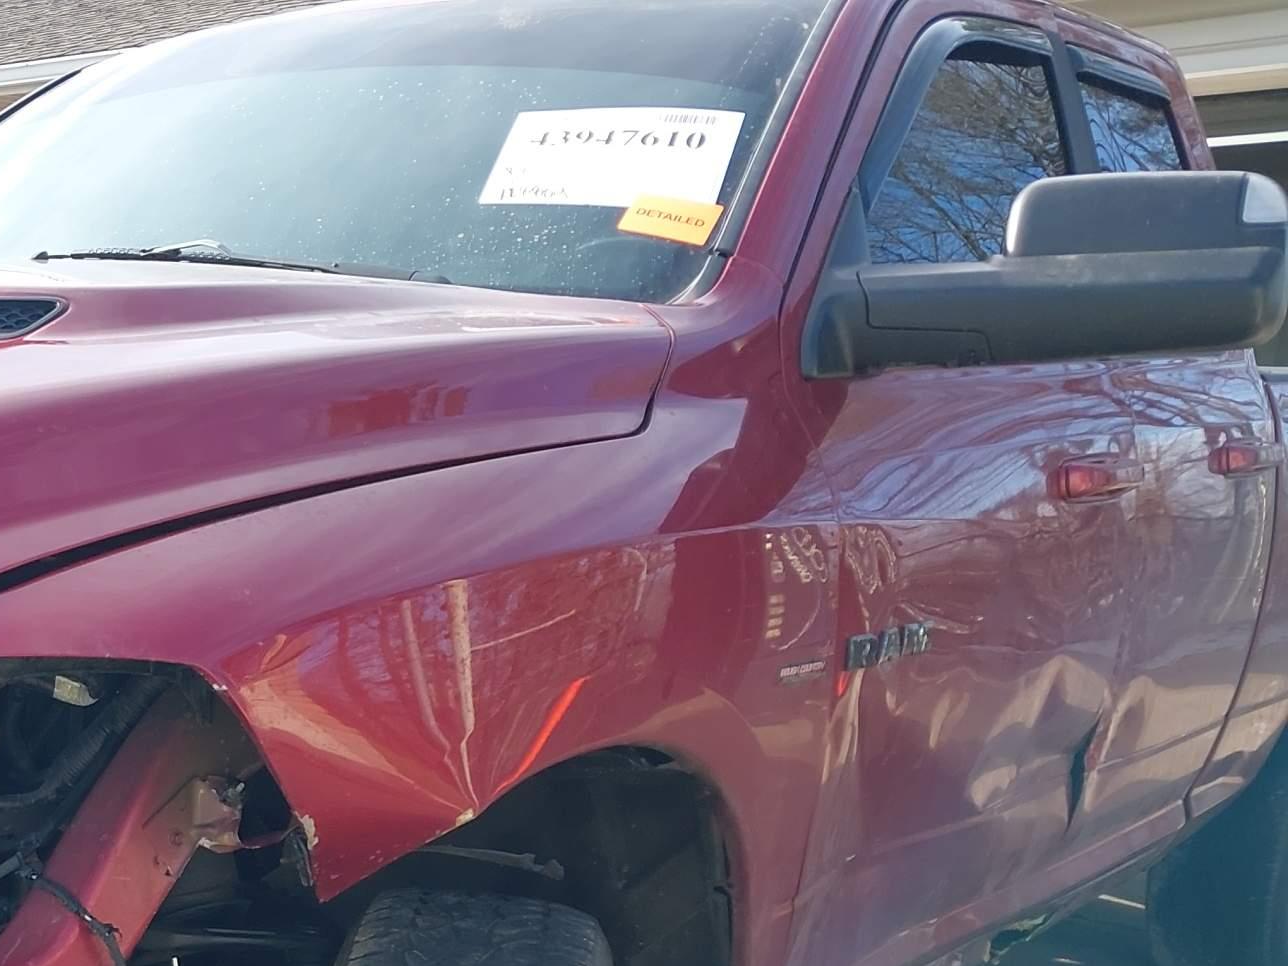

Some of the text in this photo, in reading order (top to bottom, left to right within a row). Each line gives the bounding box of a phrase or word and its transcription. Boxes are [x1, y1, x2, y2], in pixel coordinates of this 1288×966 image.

[530, 128, 708, 150] 43947610
[635, 206, 706, 229] DETAILED
[846, 620, 935, 671] RAM
